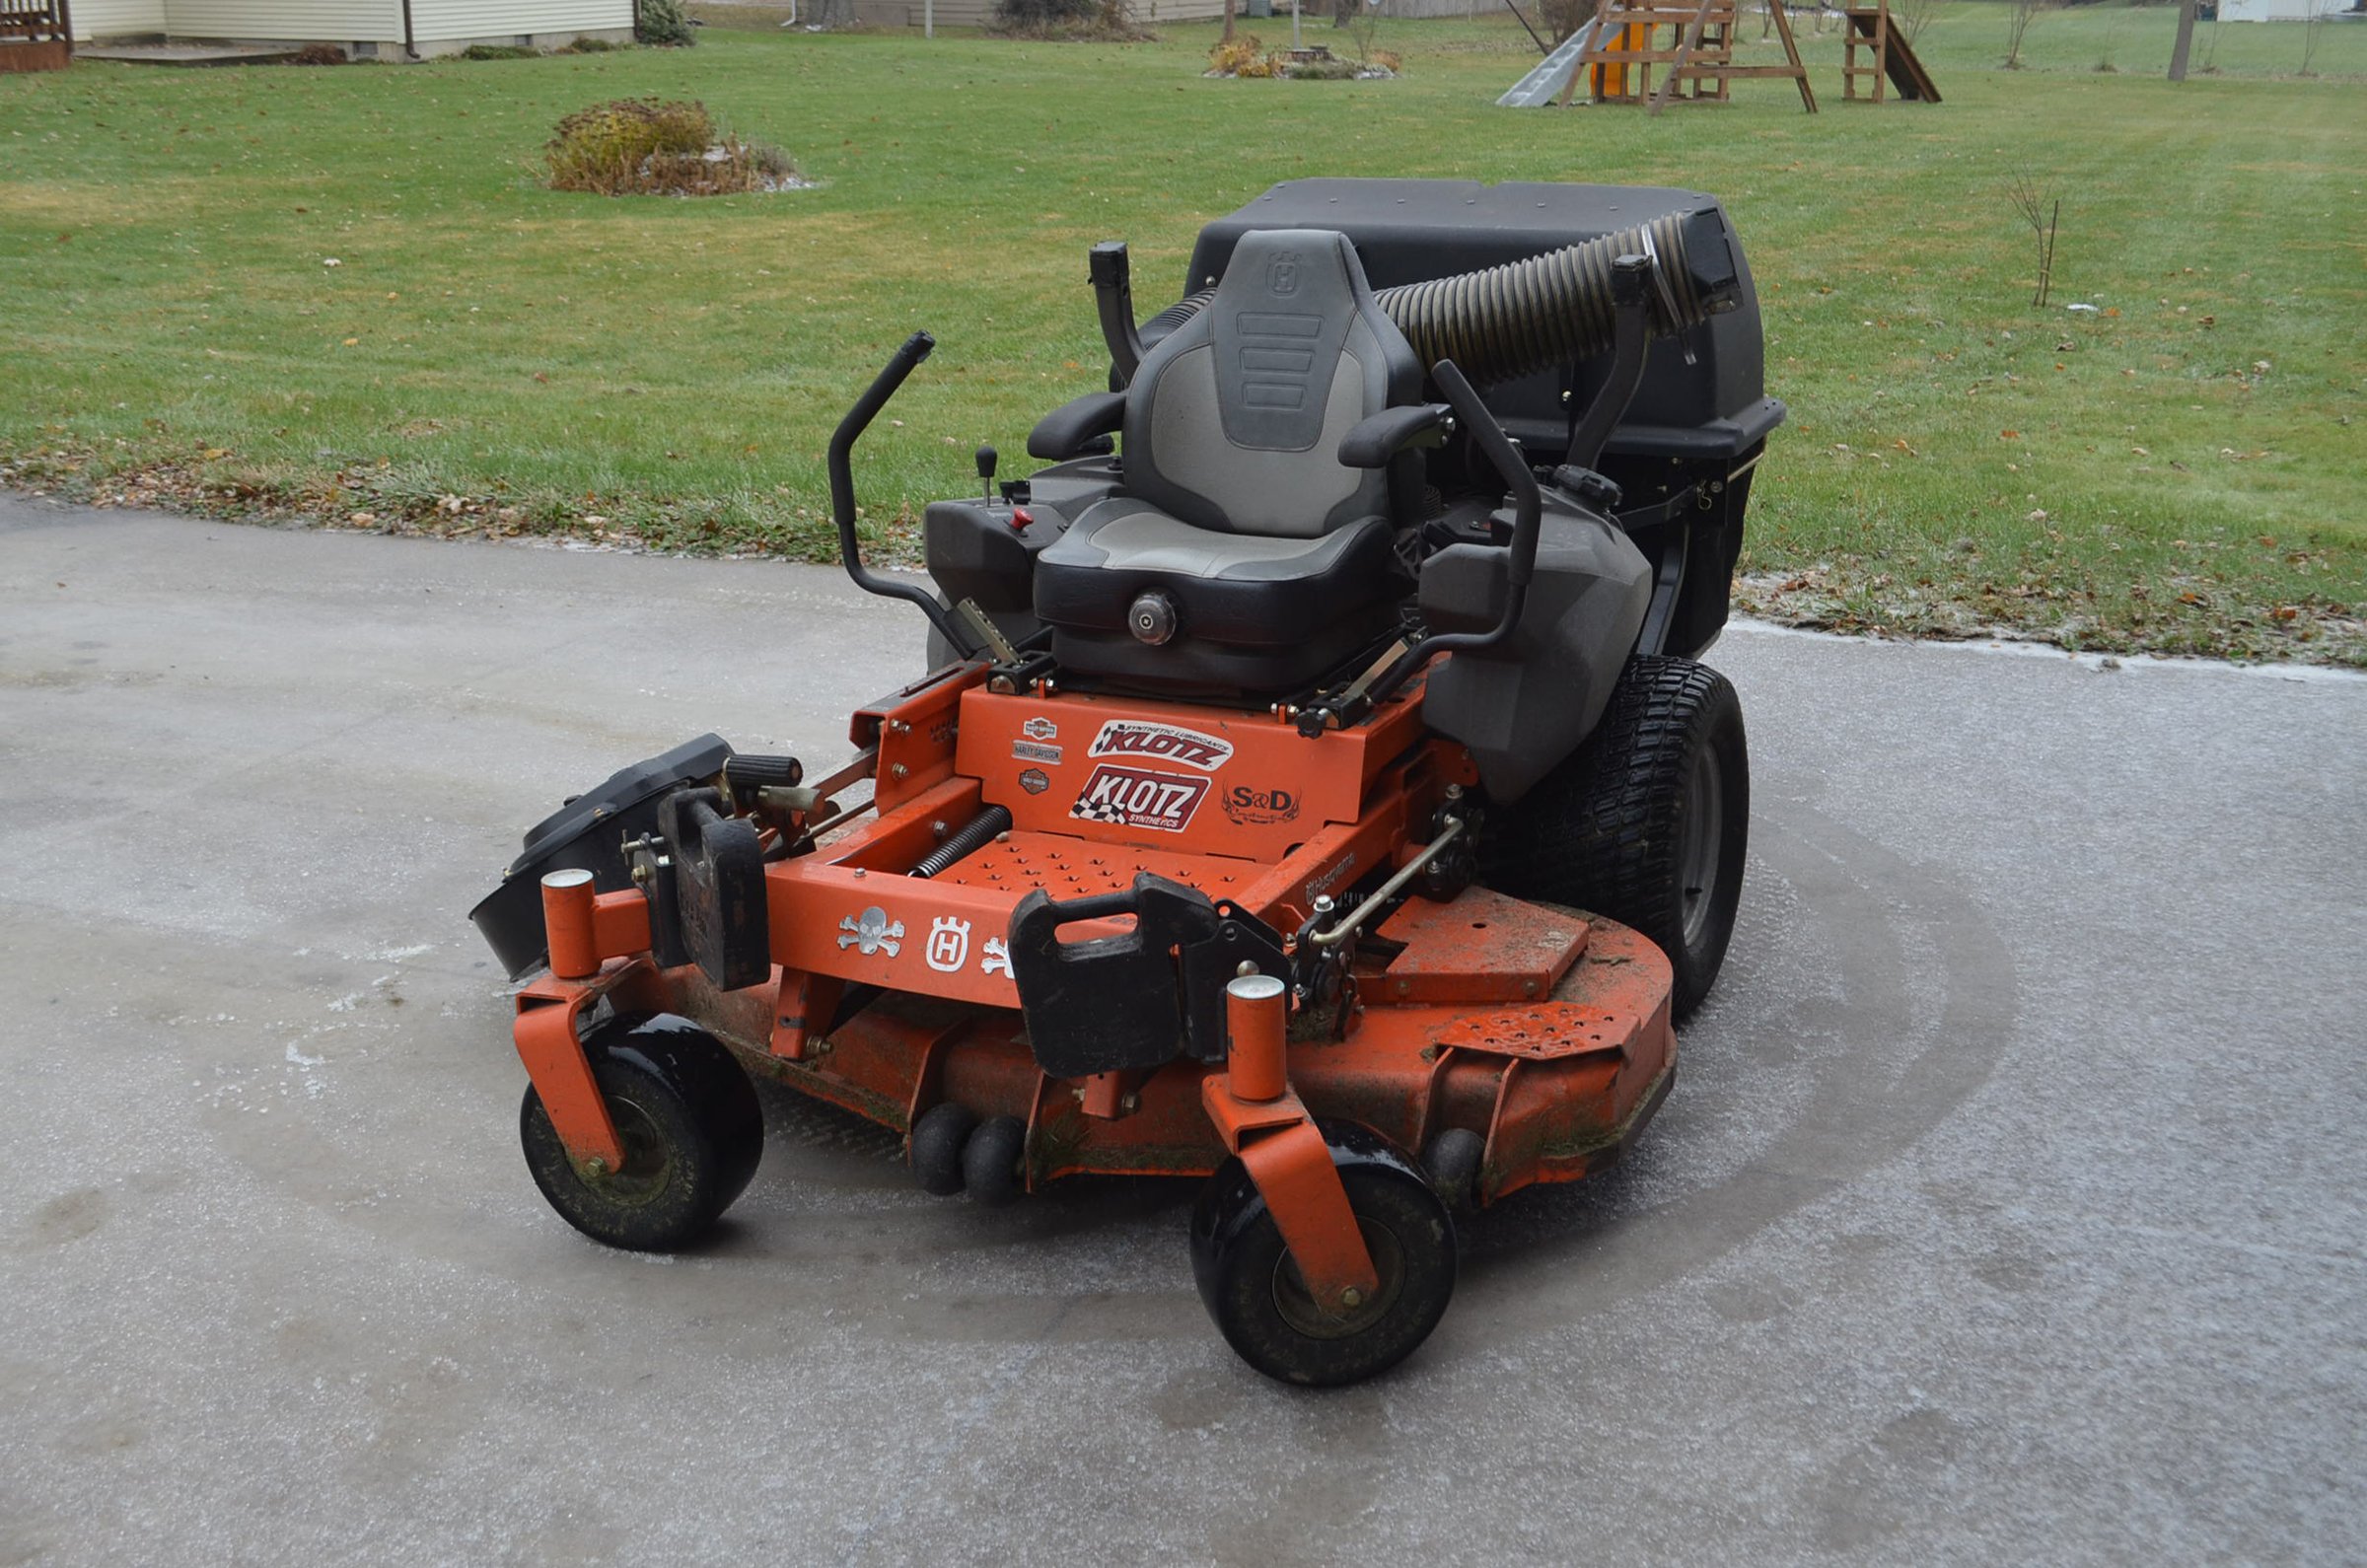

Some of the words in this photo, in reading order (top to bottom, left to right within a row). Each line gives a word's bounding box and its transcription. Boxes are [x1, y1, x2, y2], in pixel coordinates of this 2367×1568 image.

[1102, 730, 1228, 766] KLOTZ
[1124, 725, 1174, 736] SYNTHETIC
[1176, 730, 1230, 751] LUBRICANTS
[1089, 774, 1197, 819] KLOTZ
[1232, 786, 1292, 812] S&D
